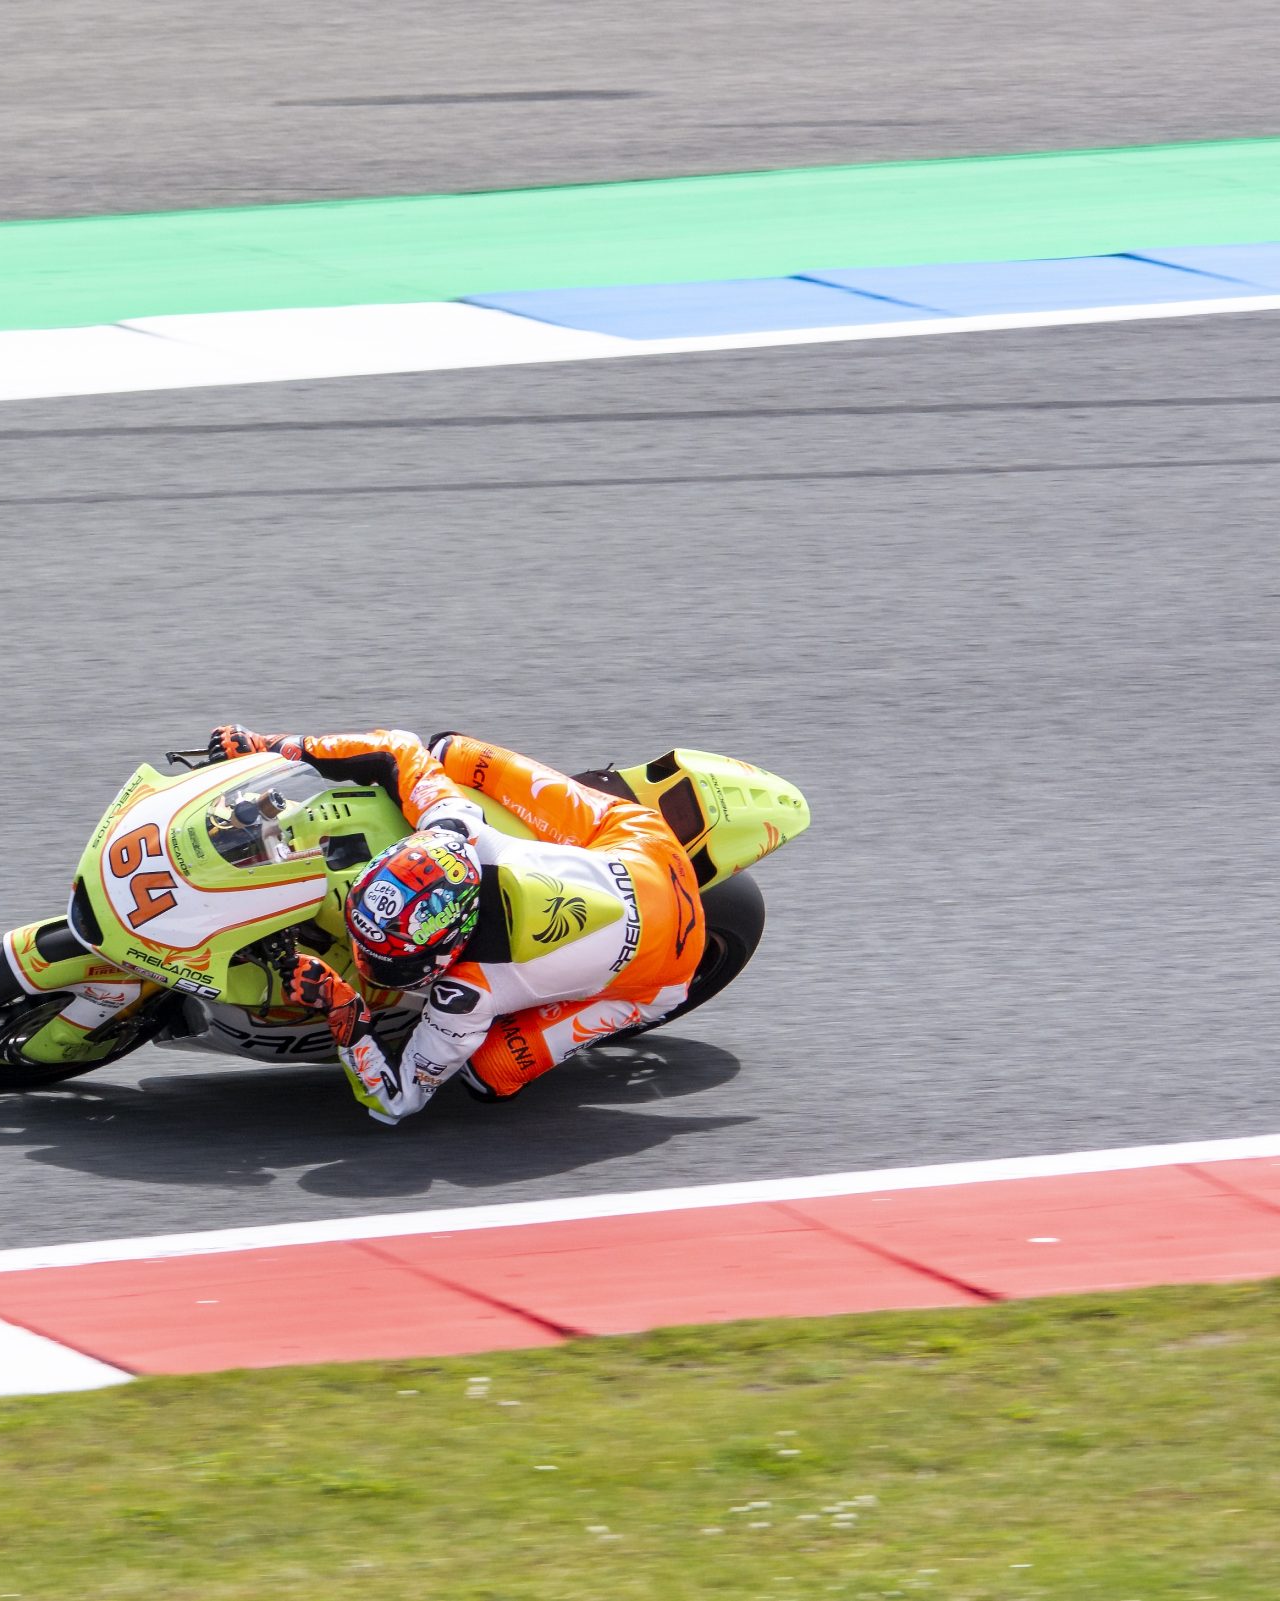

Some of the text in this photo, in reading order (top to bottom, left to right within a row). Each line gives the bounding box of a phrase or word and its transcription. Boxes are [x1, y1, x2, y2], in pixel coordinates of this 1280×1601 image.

[472, 749, 494, 791] MACN
[109, 823, 178, 929] 64
[608, 858, 640, 973] PREICANO
[87, 963, 125, 977] PIREL
[126, 947, 215, 985] PREICANOS
[423, 1012, 472, 1038] MACN
